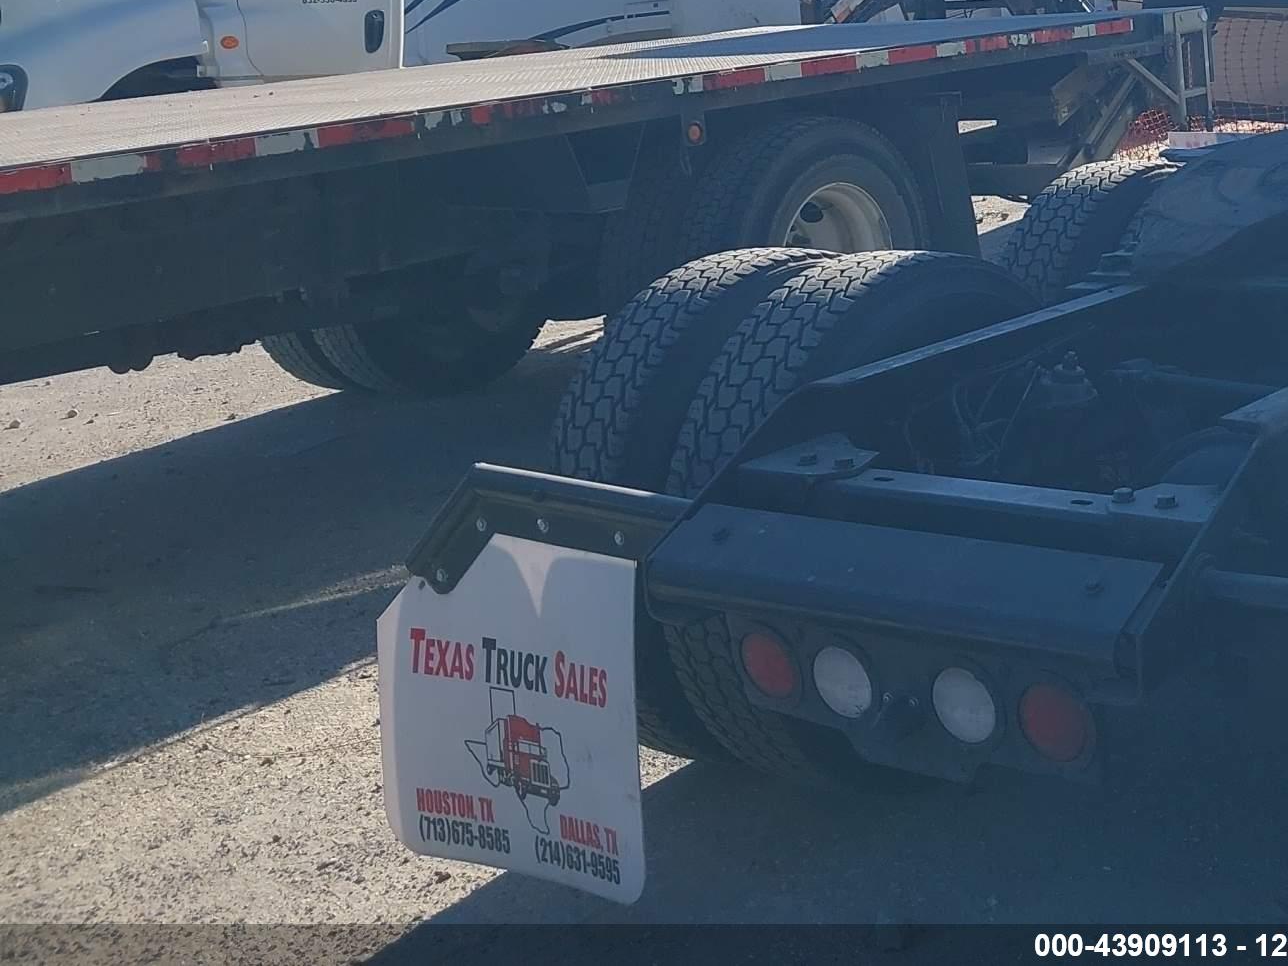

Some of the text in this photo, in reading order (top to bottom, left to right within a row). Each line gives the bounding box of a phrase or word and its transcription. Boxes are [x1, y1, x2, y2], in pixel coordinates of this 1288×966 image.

[410, 627, 608, 708] TEXAS TRUCK SALES
[416, 788, 495, 824] HOUSTON, TX
[419, 814, 511, 854] (713)675-8585
[559, 814, 619, 856] DALLAS, TX
[535, 835, 621, 885] (214)631-9595
